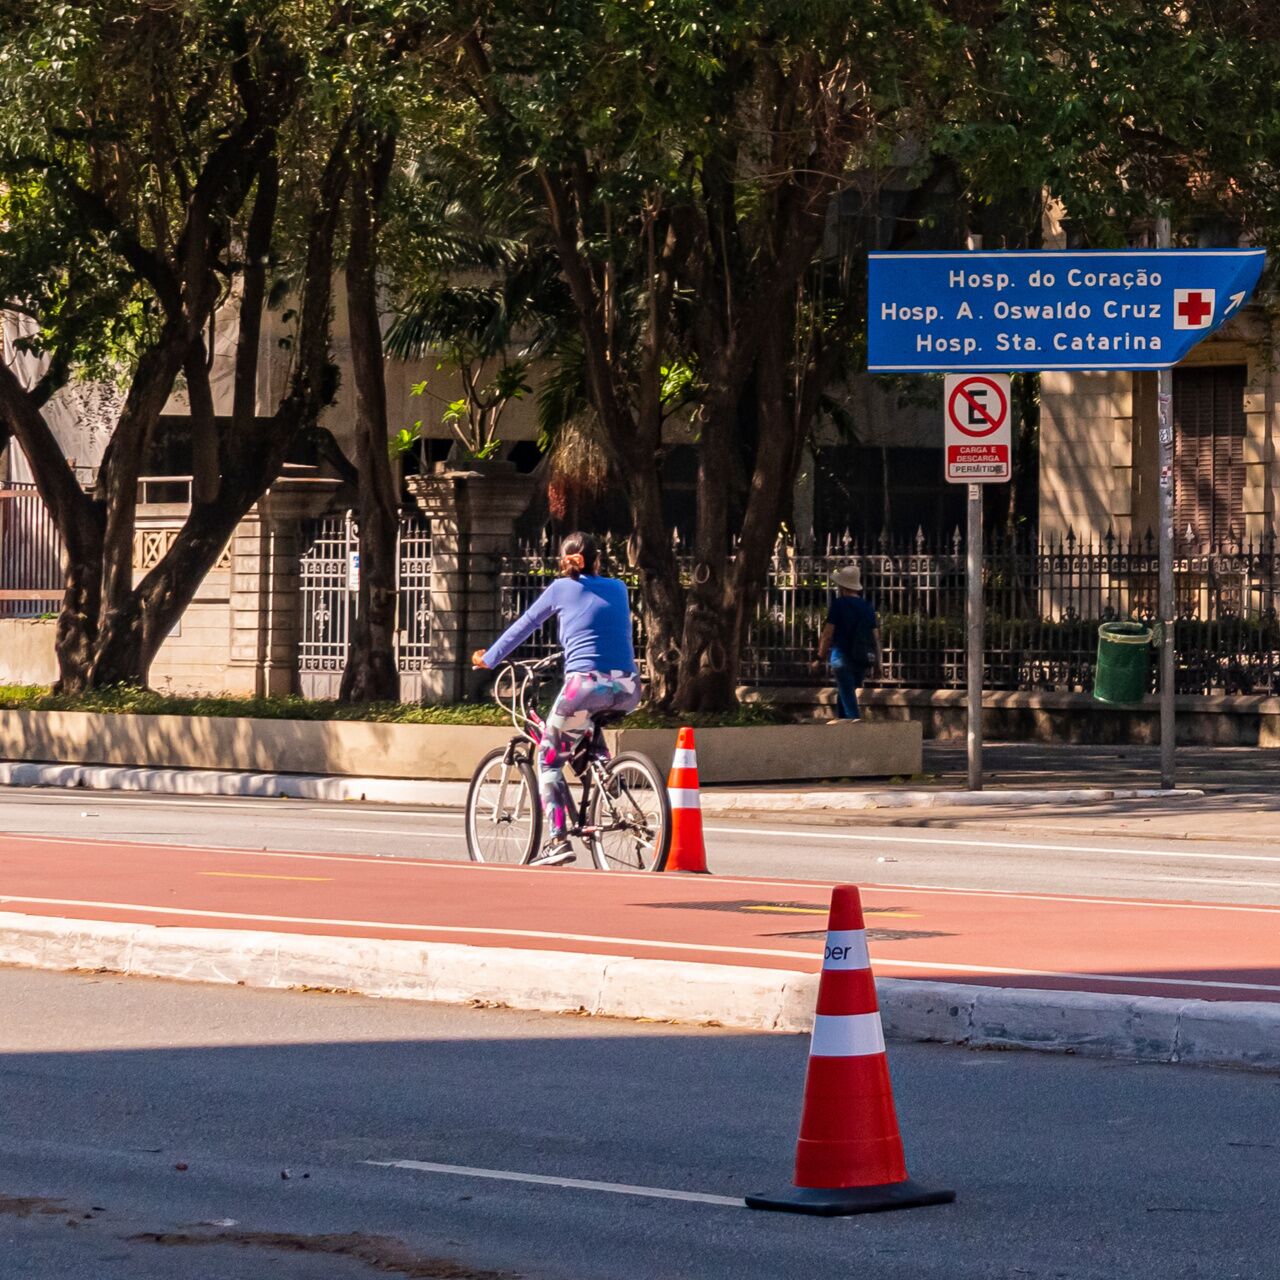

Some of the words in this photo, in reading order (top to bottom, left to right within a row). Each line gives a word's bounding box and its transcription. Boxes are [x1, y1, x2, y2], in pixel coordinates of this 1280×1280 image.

[949, 270, 1016, 290] Hosp.
[1028, 269, 1056, 288] do
[1067, 268, 1162, 291] Coração
[881, 302, 944, 324] Hosp.
[956, 302, 984, 320] A.
[993, 301, 1092, 320] Oswaldo
[1103, 300, 1161, 319] Cruz
[916, 334, 982, 355] Hosp.
[996, 333, 1042, 351] Sta.
[1053, 332, 1162, 351] Catarina
[955, 465, 1004, 474] PERMITID
